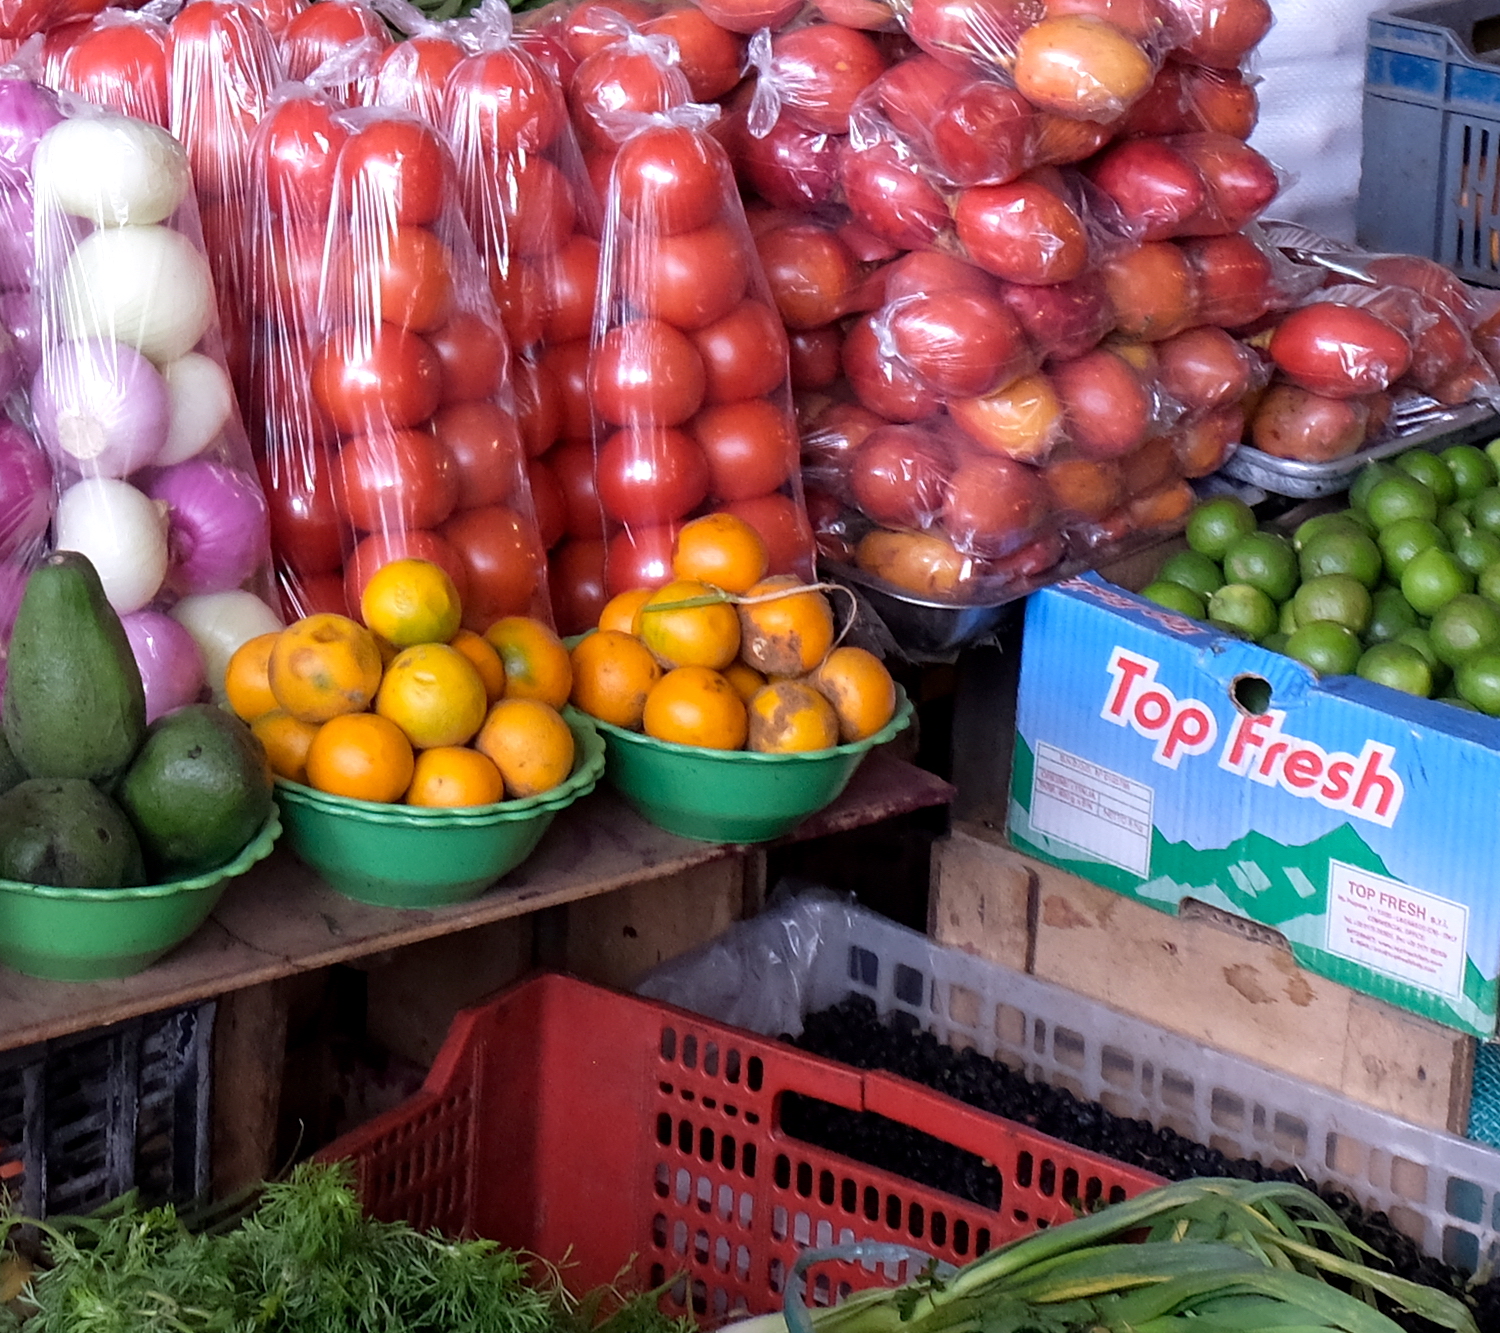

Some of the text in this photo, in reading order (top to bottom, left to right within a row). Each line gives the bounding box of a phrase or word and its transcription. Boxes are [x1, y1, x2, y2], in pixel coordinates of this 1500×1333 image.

[1110, 656, 1395, 817] Top Fresh
[1348, 881, 1375, 900] TOP
[1380, 892, 1426, 920] FRESH
